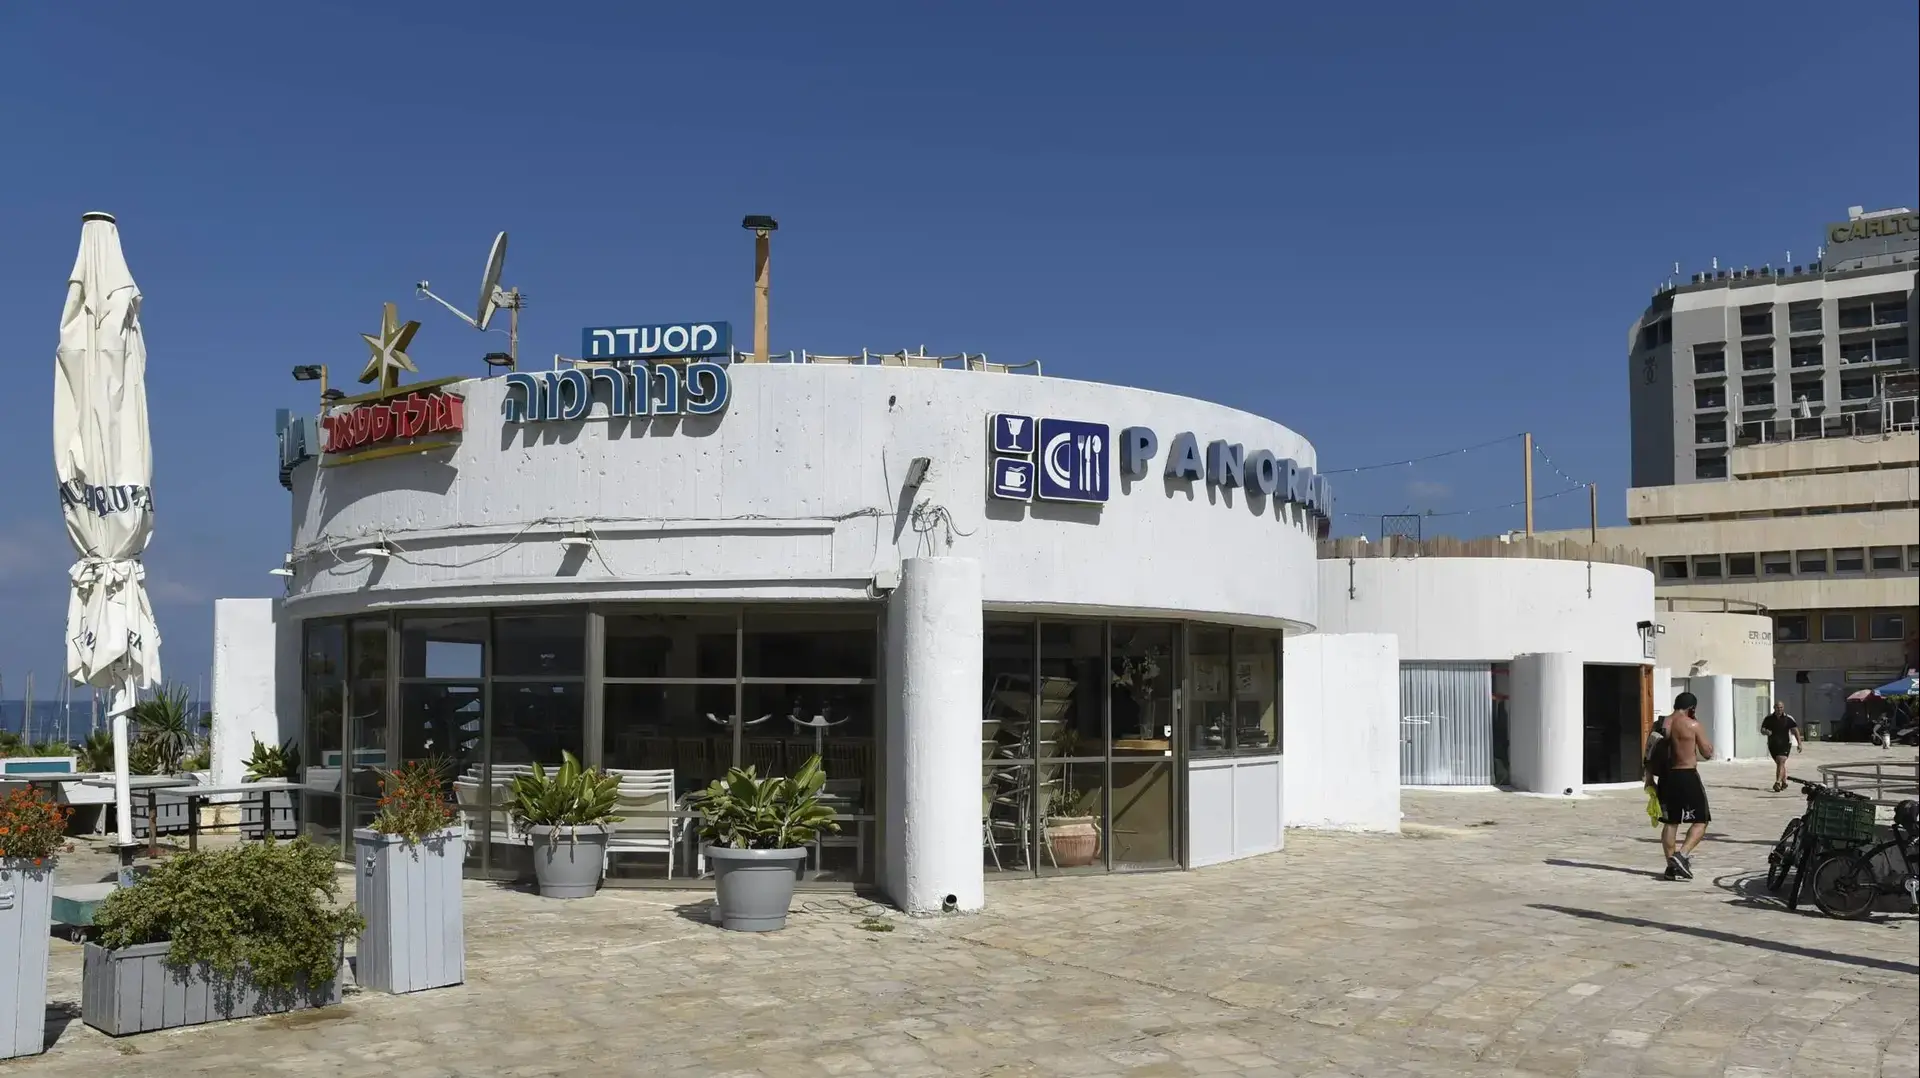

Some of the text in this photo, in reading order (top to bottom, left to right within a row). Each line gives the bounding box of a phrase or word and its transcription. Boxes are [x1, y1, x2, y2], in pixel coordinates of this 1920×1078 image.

[591, 323, 718, 356] מסעדה
[323, 392, 463, 453] גולדסטאר
[505, 362, 731, 423] פנורמה
